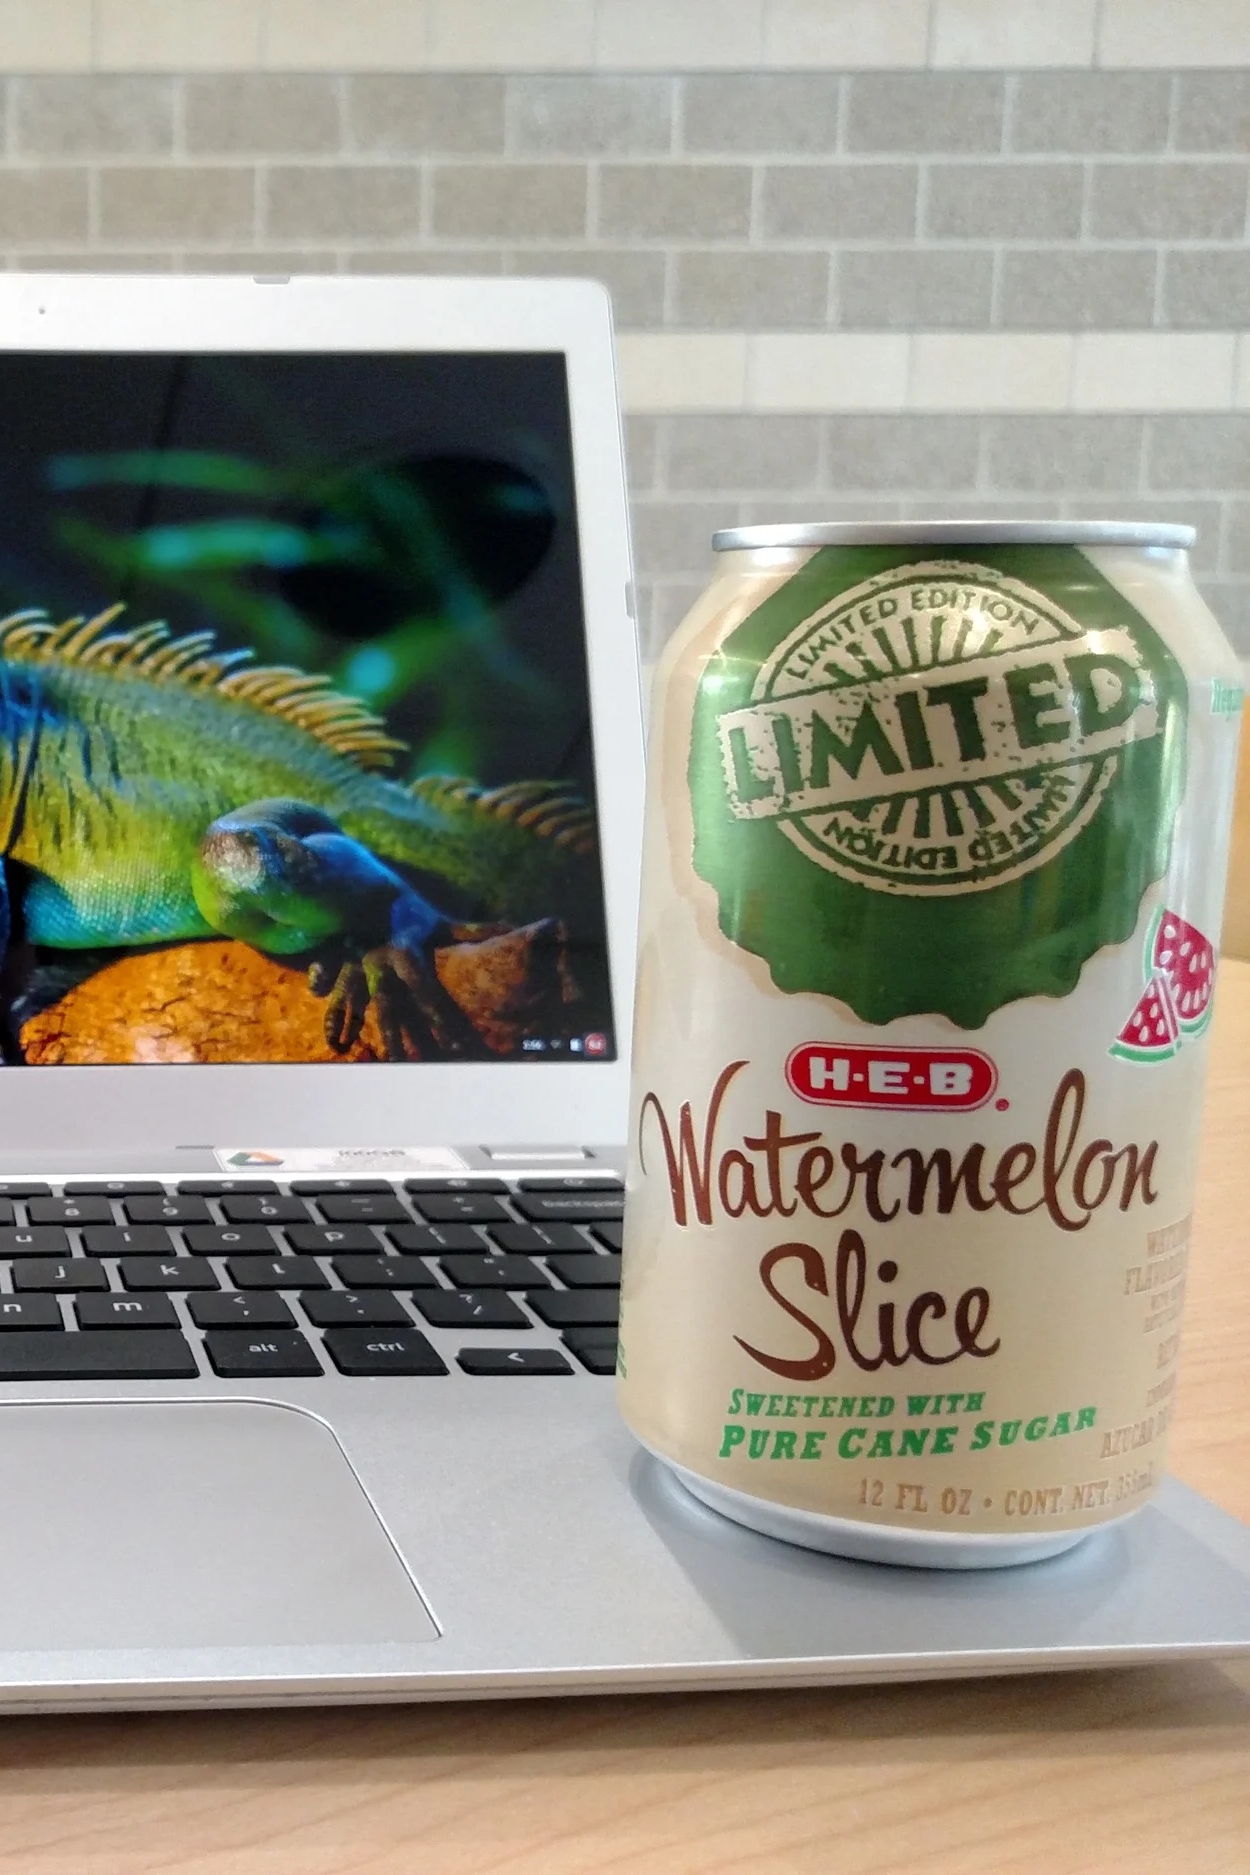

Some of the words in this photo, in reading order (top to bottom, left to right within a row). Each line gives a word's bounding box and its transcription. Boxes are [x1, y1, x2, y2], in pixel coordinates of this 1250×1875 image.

[785, 598, 898, 680] LIMITED
[909, 588, 1039, 636] EDITION
[725, 653, 1144, 802] LIMITED
[823, 817, 958, 870] EDITION
[639, 1061, 1160, 1232] Watermelon
[15, 1234, 33, 1243] u
[221, 1232, 241, 1241] o
[324, 1231, 345, 1242] p
[55, 1265, 66, 1279] j
[160, 1264, 179, 1276] k
[3, 1302, 22, 1313] n
[112, 1300, 143, 1312] m
[733, 1229, 1000, 1380] Slice
[249, 1341, 279, 1353] alt
[366, 1341, 405, 1352] ctrl
[728, 1388, 895, 1418] SWEETENED
[905, 1391, 986, 1416] WITH
[718, 1423, 827, 1459] PURE
[838, 1426, 959, 1459] CANE
[969, 1406, 1098, 1450] SUGAR
[859, 1478, 884, 1506] 12
[895, 1483, 928, 1512] FL
[941, 1487, 973, 1515] OZ
[1004, 1487, 1064, 1516] CONT.
